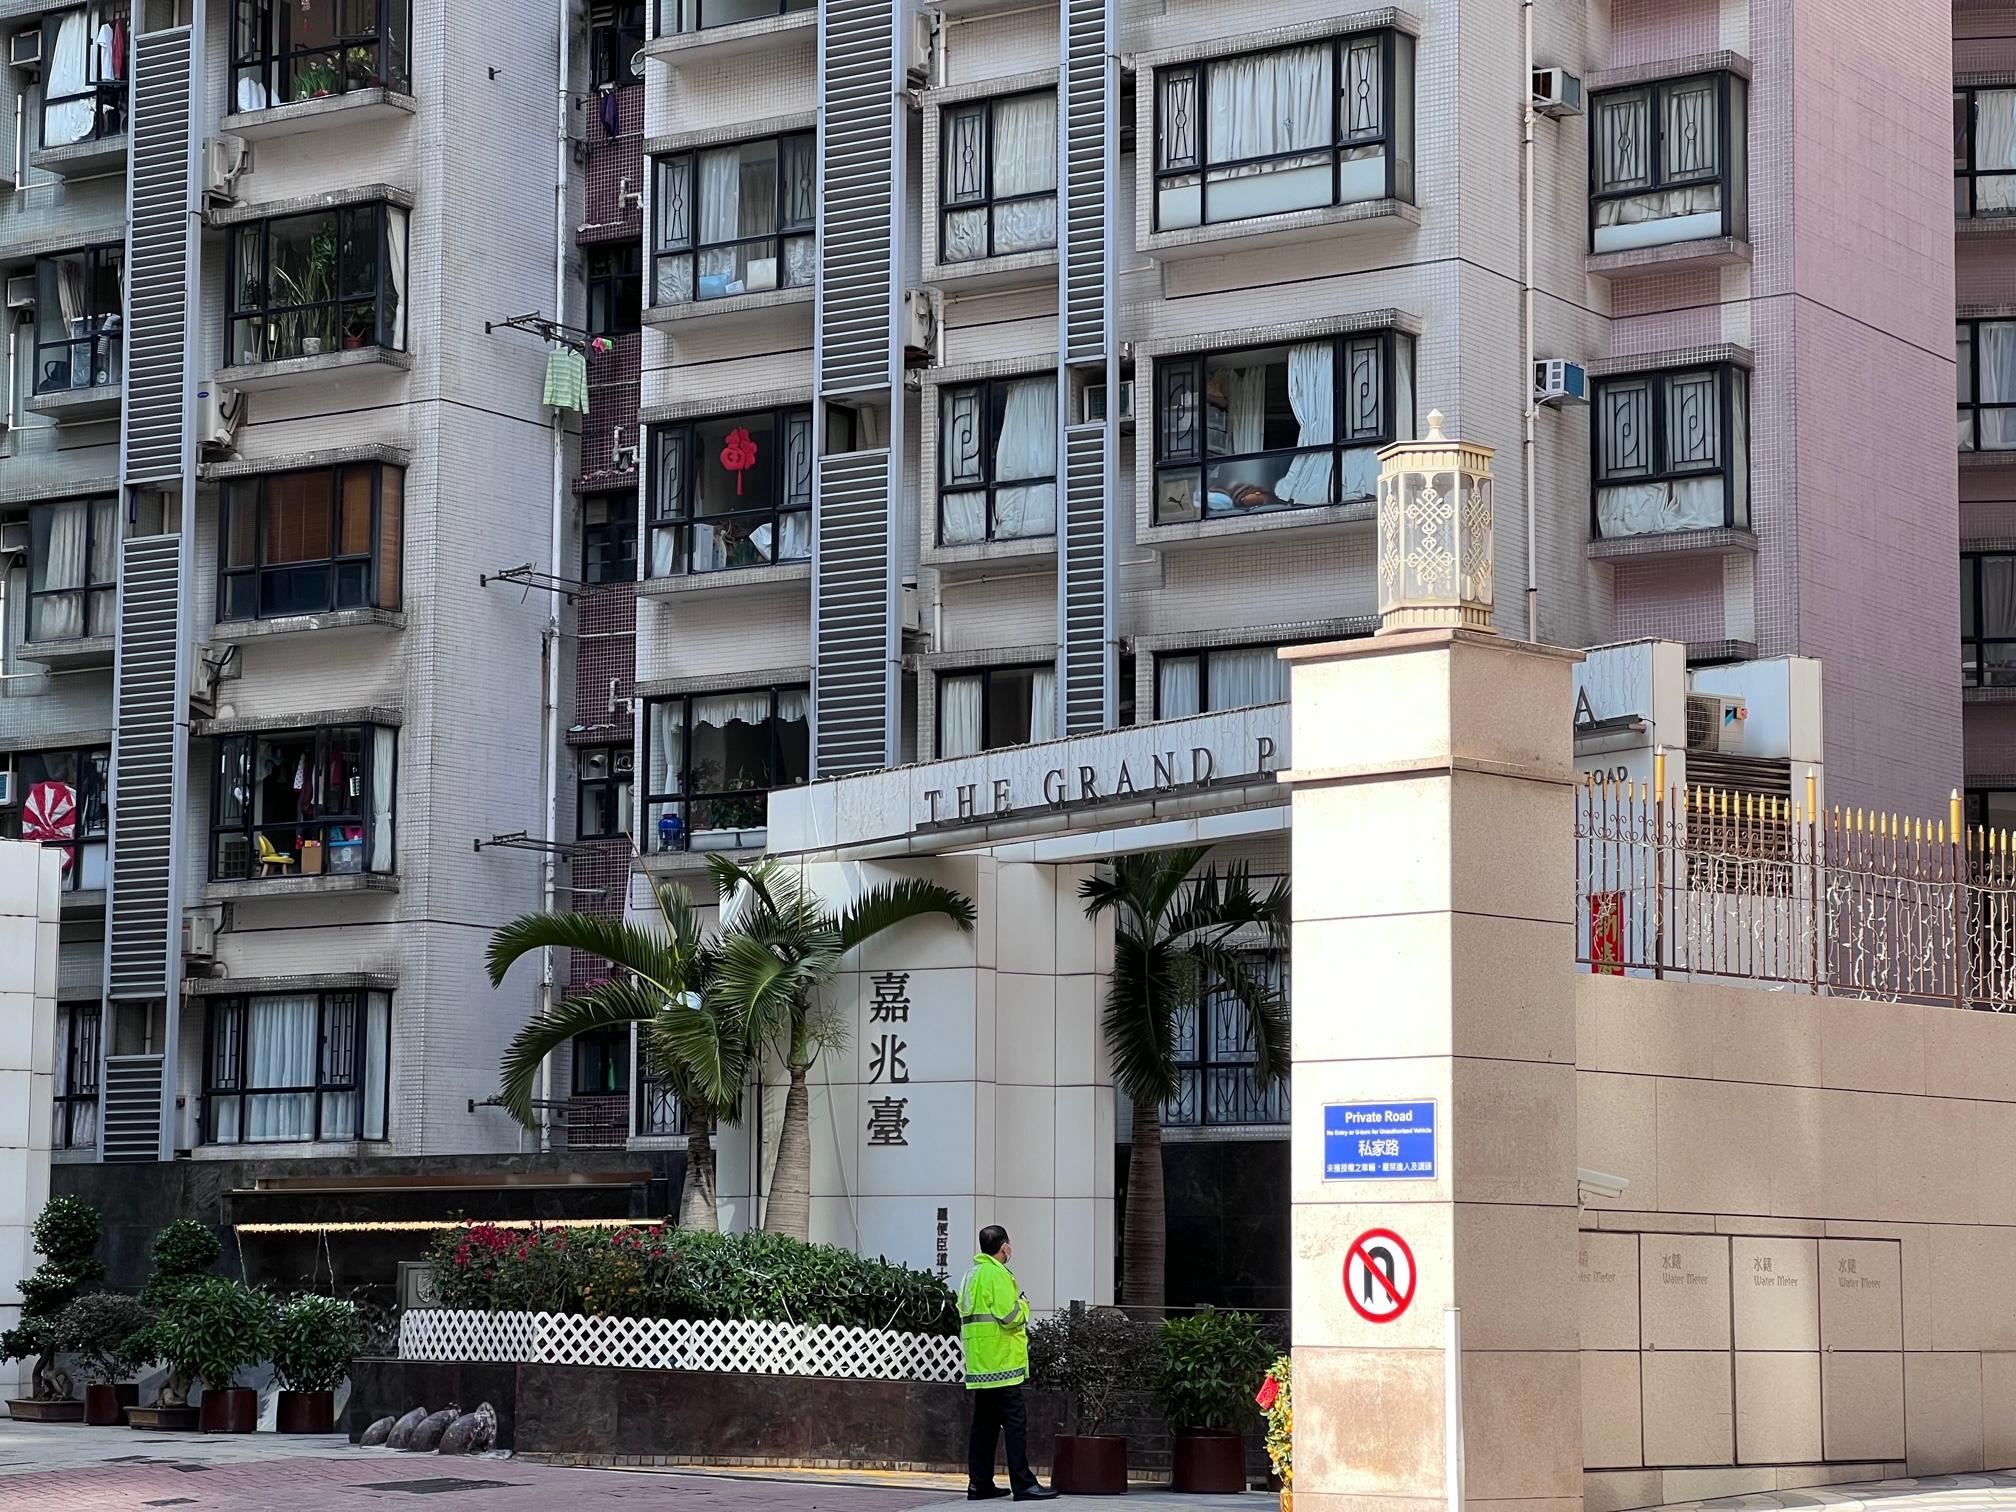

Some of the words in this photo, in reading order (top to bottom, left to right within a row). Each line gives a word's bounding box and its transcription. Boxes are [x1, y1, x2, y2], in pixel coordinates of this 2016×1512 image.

[923, 778, 1013, 826] THE
[1043, 746, 1215, 805] GRAND
[867, 971, 911, 1146] 嘉兆臺
[1345, 1111, 1382, 1123] Private
[1384, 1110, 1413, 1122] Road
[1358, 1139, 1399, 1156] 私家路
[1662, 1272, 1684, 1285] Water
[1686, 1273, 1709, 1285] Meter
[1754, 1275, 1775, 1287] Water
[1777, 1275, 1798, 1287] Meter
[1838, 1276, 1859, 1289] Water
